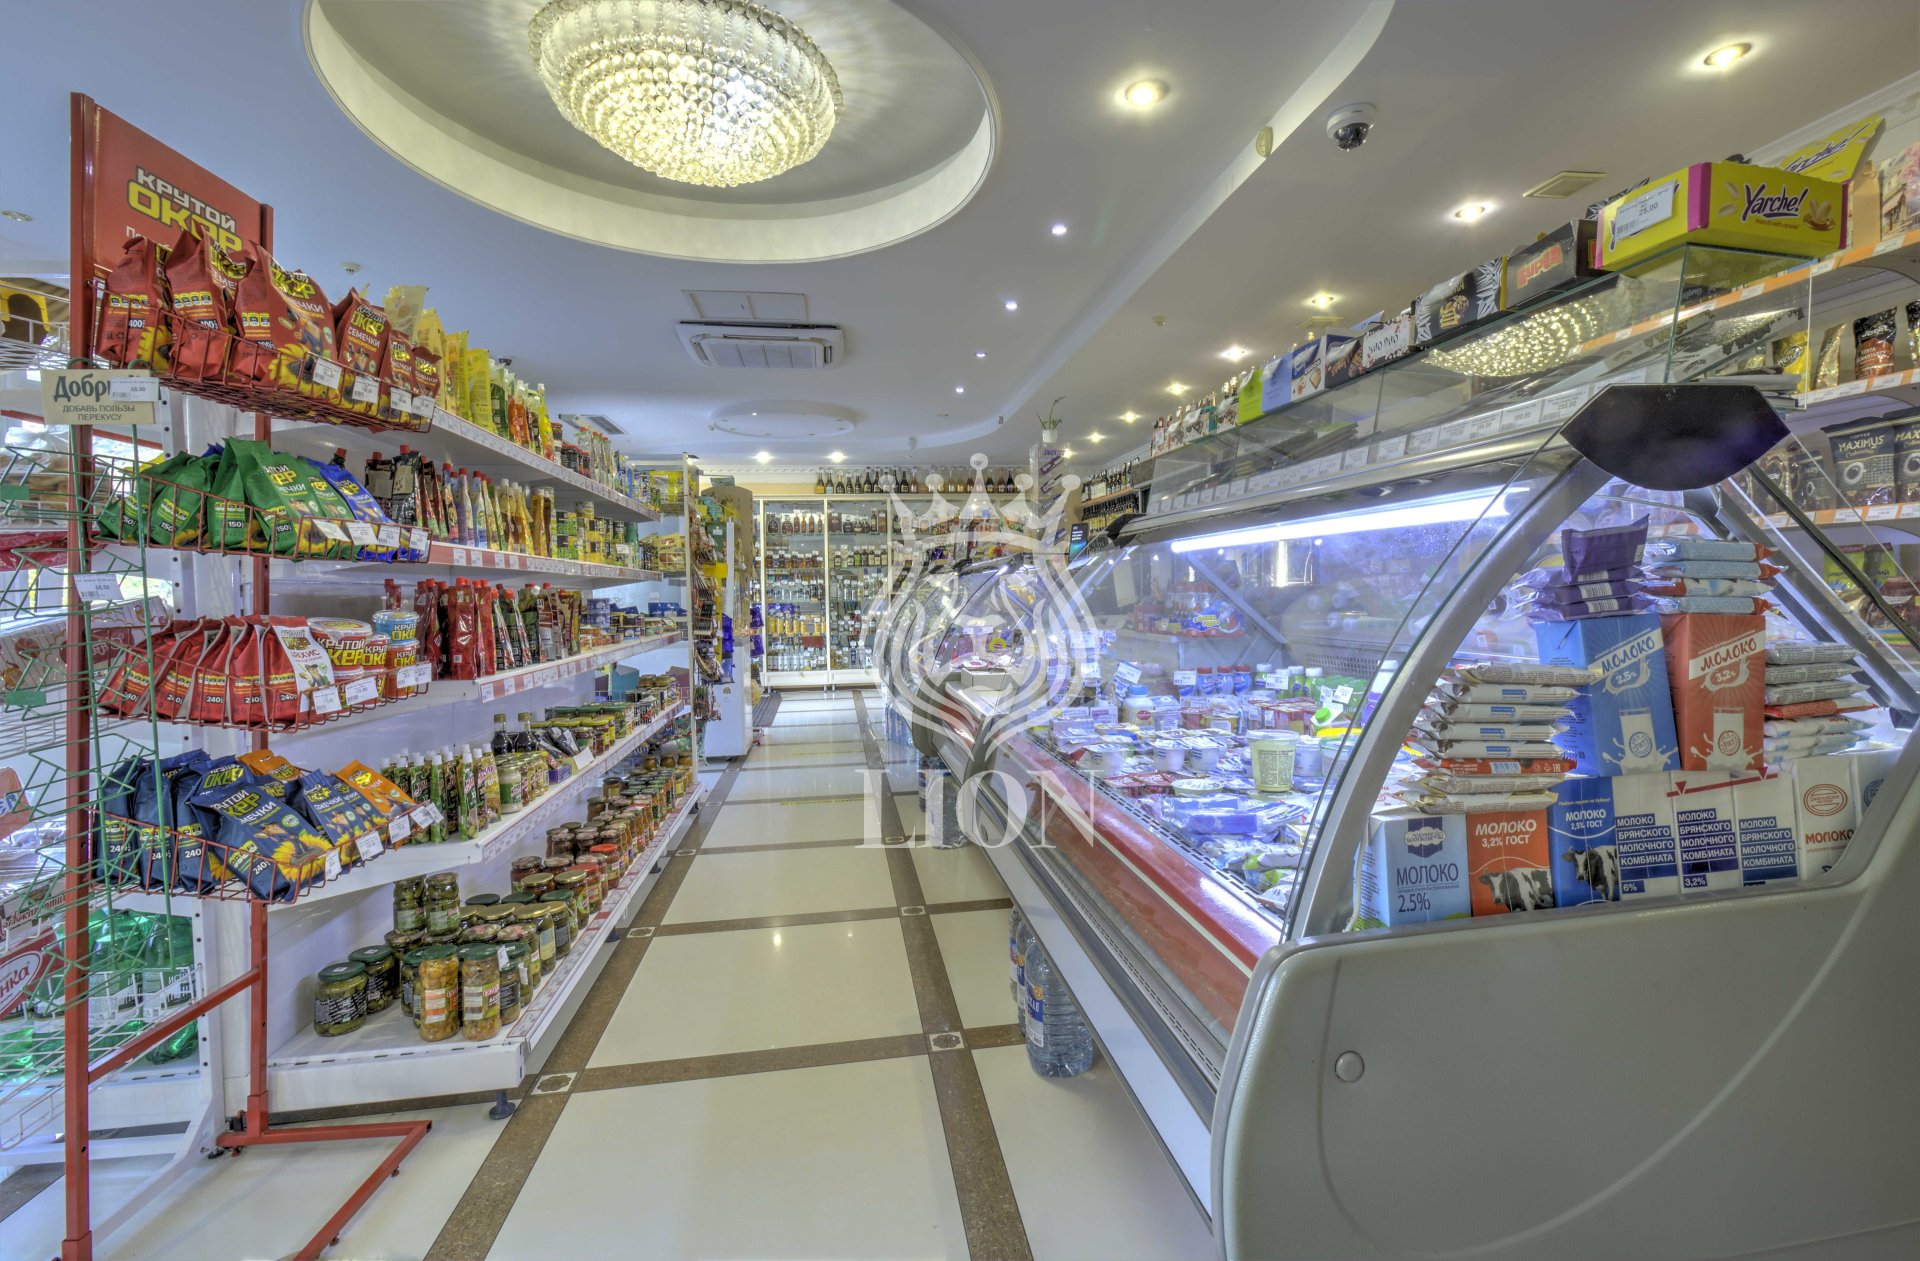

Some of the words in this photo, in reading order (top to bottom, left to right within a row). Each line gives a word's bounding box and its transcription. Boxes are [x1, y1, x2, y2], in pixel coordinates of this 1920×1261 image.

[137, 167, 236, 233] КРУТОЙ
[1742, 184, 1809, 221] Yarche!
[347, 326, 380, 349] СЕМЕЧКИ
[54, 373, 111, 402] Добр
[62, 405, 98, 413] ДОБАВЬ
[1838, 435, 1885, 452] MAXIMUS
[1601, 636, 1655, 676] МОЛОКО
[1700, 637, 1757, 672] МОЛОКО
[240, 801, 277, 825] МЕЧКИ
[1565, 809, 1606, 822] МОЛОКО
[1678, 810, 1715, 822] МОЛОКО
[1586, 820, 1603, 828] ГОСТ
[1617, 816, 1654, 826] МОЛОКО
[1740, 818, 1775, 829] МОЛОКО
[1475, 819, 1537, 837] МОЛОКО
[1618, 827, 1670, 840] БРЯНСКОГО
[1680, 822, 1731, 835] БРЯНСКОГО
[1482, 837, 1503, 848] 3,2%
[1505, 834, 1530, 845] ГОСТ
[1681, 834, 1735, 848] МОЛОЧНОГО
[1741, 830, 1791, 842] БРЯНСКОГО
[1805, 829, 1855, 845] МОЛОКО
[1620, 840, 1674, 853] МОЛОЧНОГО
[1742, 842, 1794, 855] МОЛОЧНОГО
[1621, 853, 1674, 866] КОМБИНАТА
[1682, 848, 1735, 861] КОМБИНАТА
[1743, 855, 1794, 867] КОМБИНАТА
[1396, 863, 1459, 886] МОЛОКО
[1685, 877, 1706, 887] 3,2%
